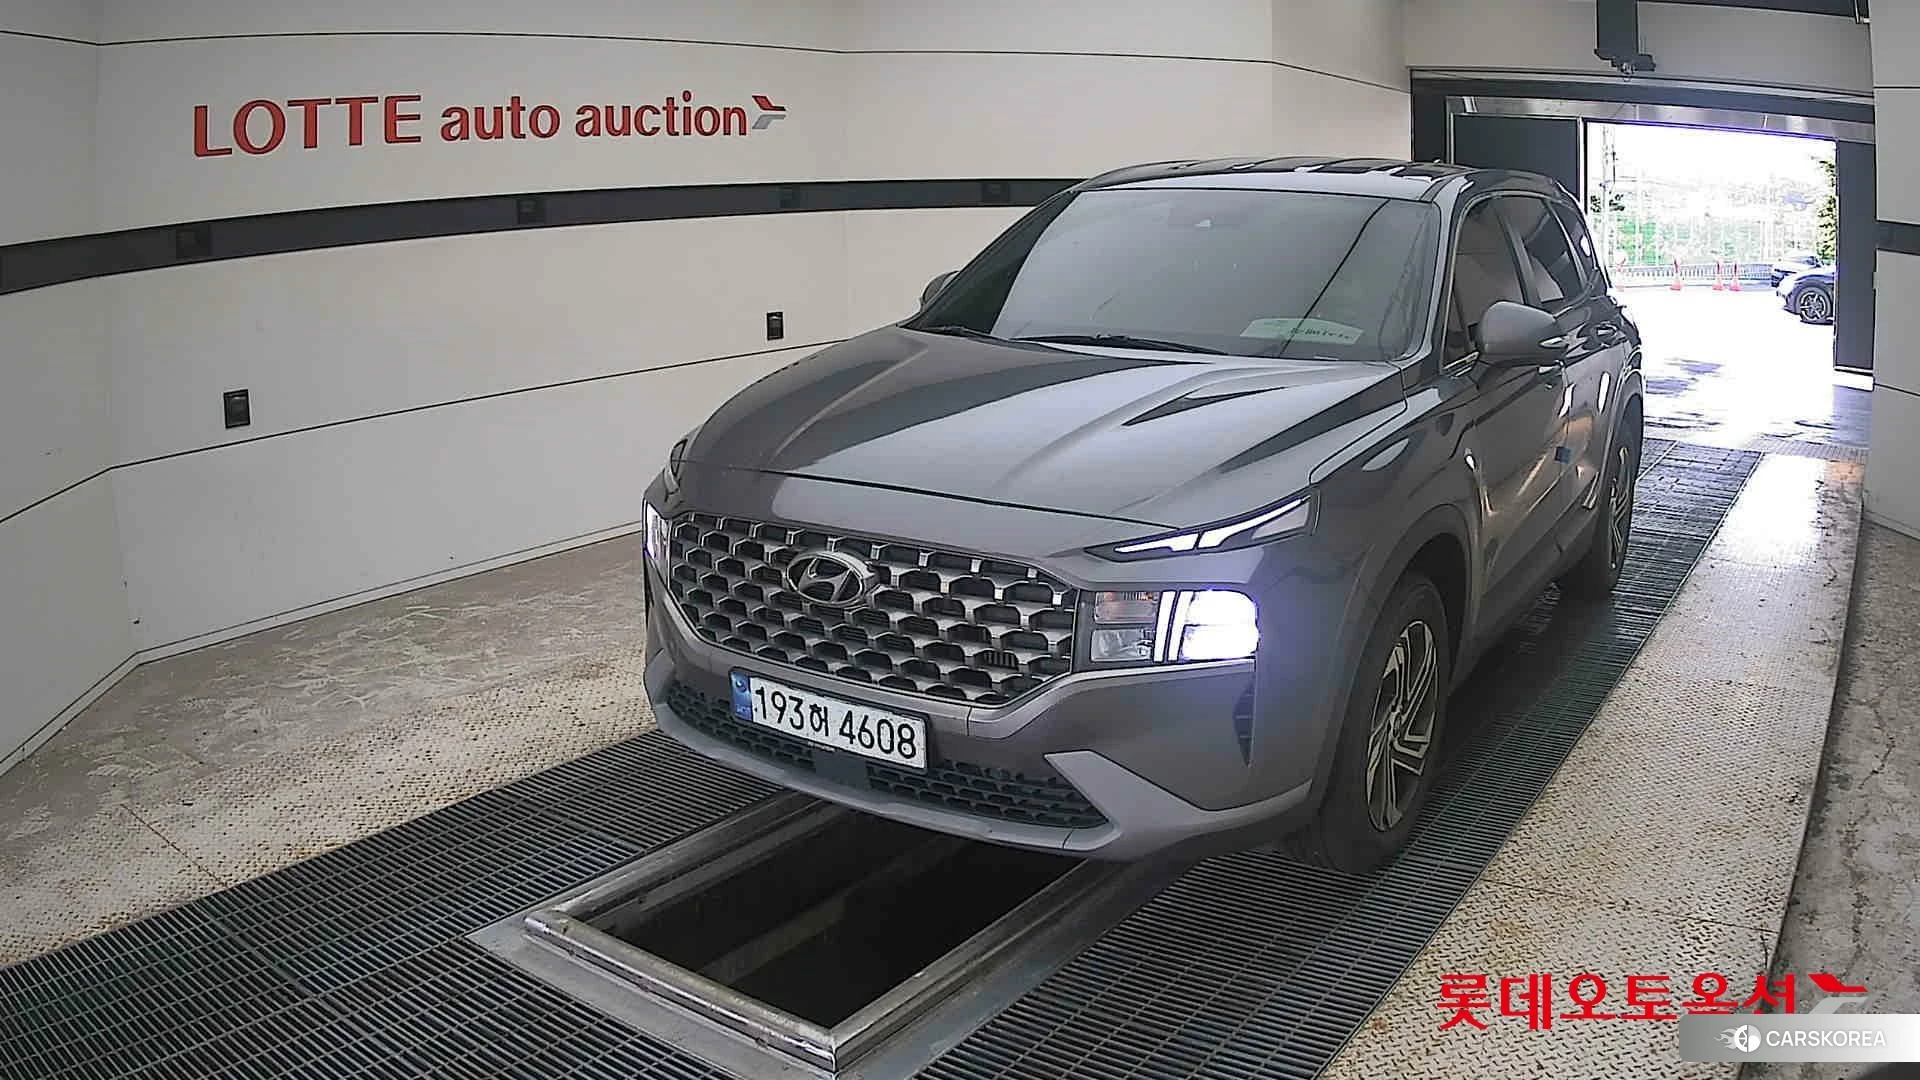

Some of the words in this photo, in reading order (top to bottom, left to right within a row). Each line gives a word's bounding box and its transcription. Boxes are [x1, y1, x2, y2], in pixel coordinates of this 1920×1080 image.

[194, 95, 422, 157] LOTTE
[440, 96, 560, 141] auto
[575, 90, 747, 137] auction
[755, 686, 829, 736] 193허
[839, 710, 916, 759] 4608
